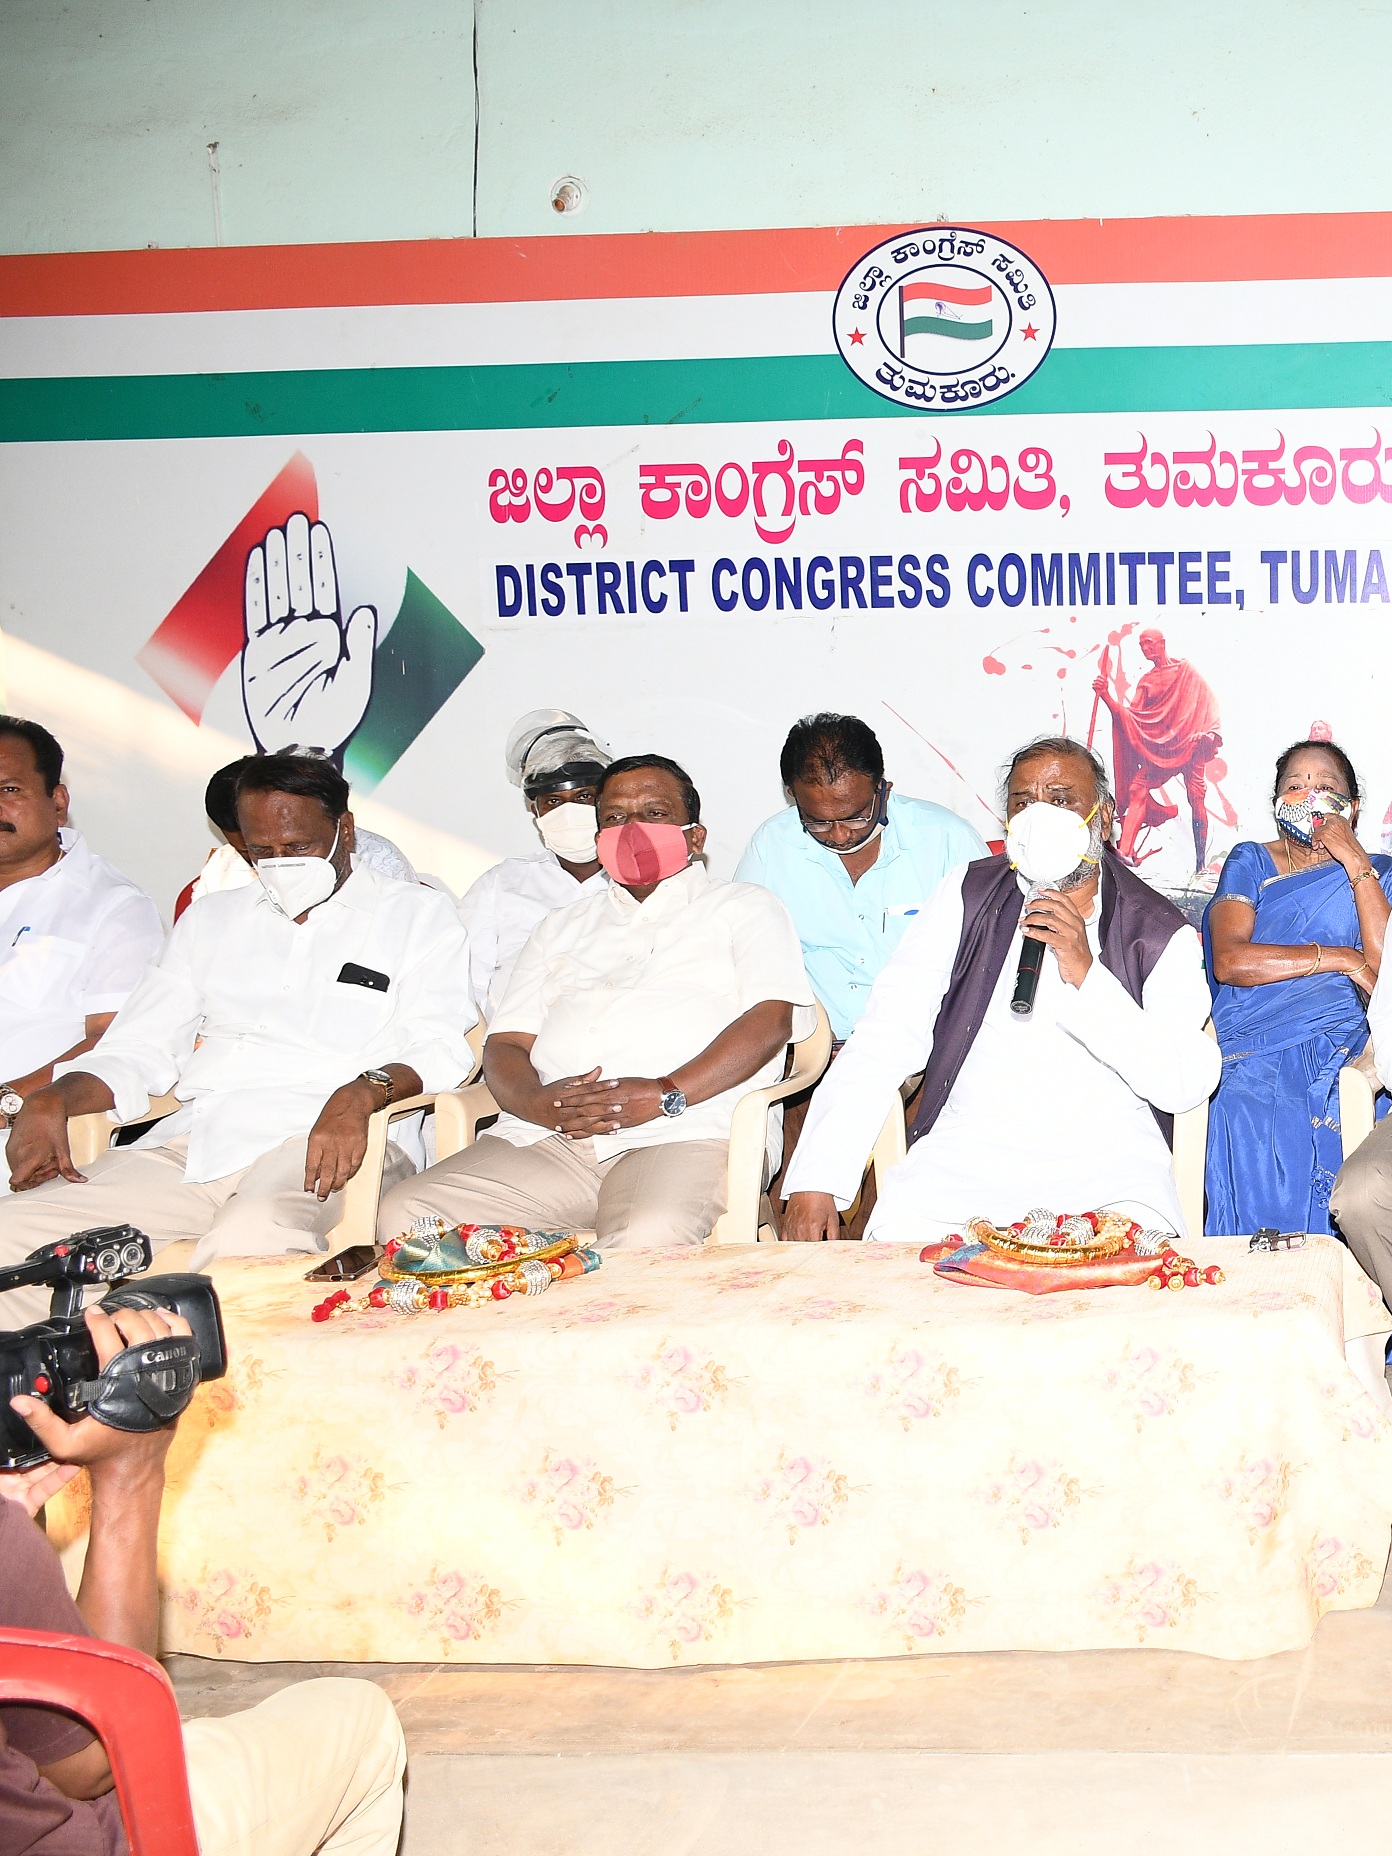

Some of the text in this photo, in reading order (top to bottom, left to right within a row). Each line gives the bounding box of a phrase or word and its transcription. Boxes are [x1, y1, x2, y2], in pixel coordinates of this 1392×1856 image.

[852, 231, 1037, 311] ಜಿಲ್ಲಾ ಕಾಂಗ್ರೆಸ್ ಸಮಿತಿ
[875, 361, 1017, 404] ತುಮಕೂರು.
[487, 465, 609, 550] ಜಿಲ್ಲಾ
[638, 438, 866, 545] ಕಾಂಗ್ರೆಸ್
[898, 436, 1071, 518] ಸಮಿತಿ,
[495, 558, 696, 618] DISTRICT
[710, 553, 952, 613] CONGRESS
[966, 550, 1245, 611] COMMITTEE,
[141, 1346, 187, 1365] Canon
